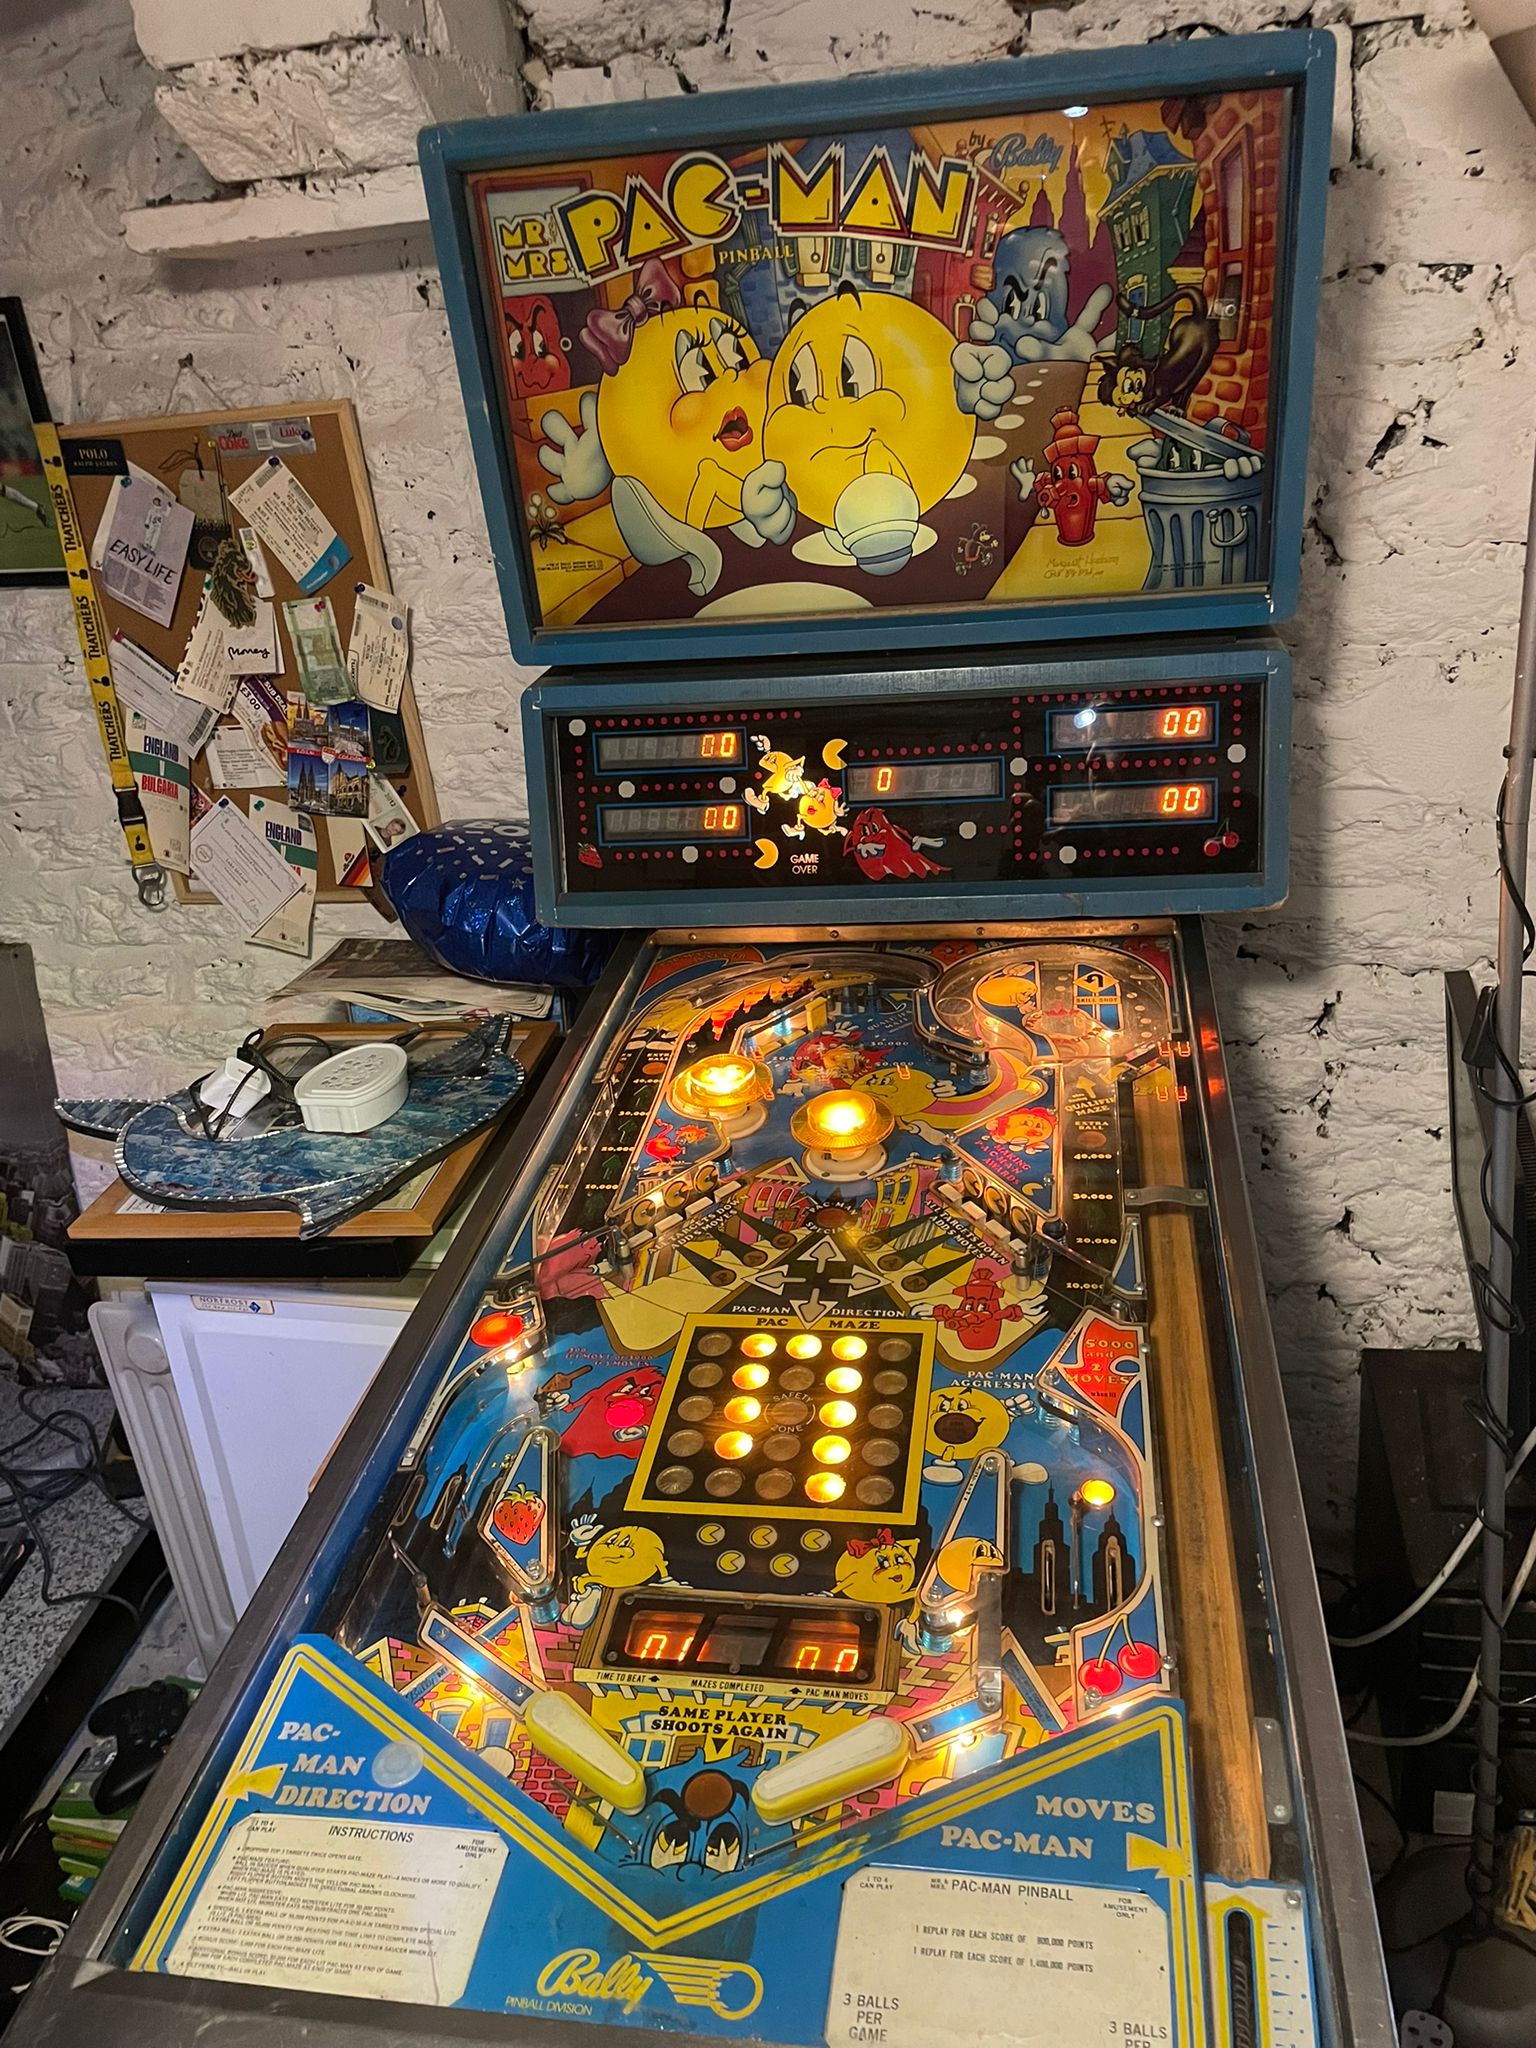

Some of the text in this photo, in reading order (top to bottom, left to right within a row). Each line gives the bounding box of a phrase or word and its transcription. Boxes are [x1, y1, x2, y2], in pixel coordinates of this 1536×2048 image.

[969, 131, 986, 149] by
[989, 132, 1065, 172] Bally
[553, 143, 976, 281] PAC-MAN
[718, 243, 795, 265] PINBALL
[218, 436, 248, 450] Coke
[79, 448, 108, 460] POLO
[51, 484, 77, 553] THATCHERS
[110, 539, 178, 585] EASY LIFE
[76, 595, 101, 661] THATCHERS
[99, 701, 122, 762] THATCHERS
[143, 735, 179, 762] ENGLAND
[141, 775, 178, 800] BULGARIA
[265, 821, 302, 845] ENGLAND
[790, 853, 819, 864] GAME
[791, 864, 818, 875] OVER
[700, 1208, 738, 1232] MOVES
[805, 1221, 848, 1235] SPECIAL
[941, 1212, 980, 1243] TARGETS
[977, 1240, 1009, 1265] DOWN
[954, 1233, 986, 1259] MOVES
[1075, 1237, 1117, 1245] 20,000
[831, 1308, 906, 1317] DIRECTION
[755, 1317, 880, 1330] PAC MAZE
[1084, 1338, 1135, 1349] 5000
[950, 1379, 1036, 1390] AGGRESSIV
[1065, 1373, 1131, 1385] MOVES
[773, 1391, 813, 1402] SAFETY
[771, 1424, 804, 1433] ZONE
[596, 1671, 647, 1683] TIME TO BEAT
[690, 1679, 765, 1693] MAZES COMPLETED
[842, 1690, 869, 1701] MOVES
[658, 1705, 787, 1726] SAME PLAYER
[277, 1721, 340, 1743] PAC-
[650, 1719, 789, 1740] SHOOTS AGAIN
[291, 1753, 366, 1777] MAN
[275, 1785, 432, 1816] DIRECTION
[1035, 1794, 1157, 1825] MOVES
[328, 1825, 415, 1844] INSTRUCTIONS
[940, 1825, 1094, 1861] PAC-MAN
[455, 1844, 497, 1855] AMUSEMENT
[464, 1851, 484, 1859] ONLY
[876, 1883, 893, 1891] PLAY
[951, 1879, 1074, 1901] PAC-MAN PINBALL
[1103, 1903, 1148, 1914] AMUSEMENT
[1116, 1911, 1135, 1920] ONLY
[923, 1926, 948, 1936] REPLAY
[952, 1928, 965, 1937] FOR
[969, 1929, 987, 1939] EACH
[990, 1932, 1014, 1943] SCORE
[1017, 1934, 1026, 1943] OF
[1067, 1939, 1094, 1950] POINTS
[920, 1948, 946, 1958] REPLAY
[950, 1950, 964, 1960] FOR
[967, 1952, 985, 1962] EACH
[989, 1955, 1012, 1966] SCORE
[1016, 1957, 1025, 1966] OF
[1067, 1961, 1093, 1973] POINTS
[536, 1948, 654, 2015] Bally
[505, 1995, 593, 2016] PINBALL DIVISION
[842, 1992, 900, 2011] 3 BALLS
[856, 2010, 883, 2025] PER
[848, 2025, 888, 2042] GAME
[1109, 2020, 1168, 2040] 3 BALLS
[1125, 2038, 1151, 2048] PER
